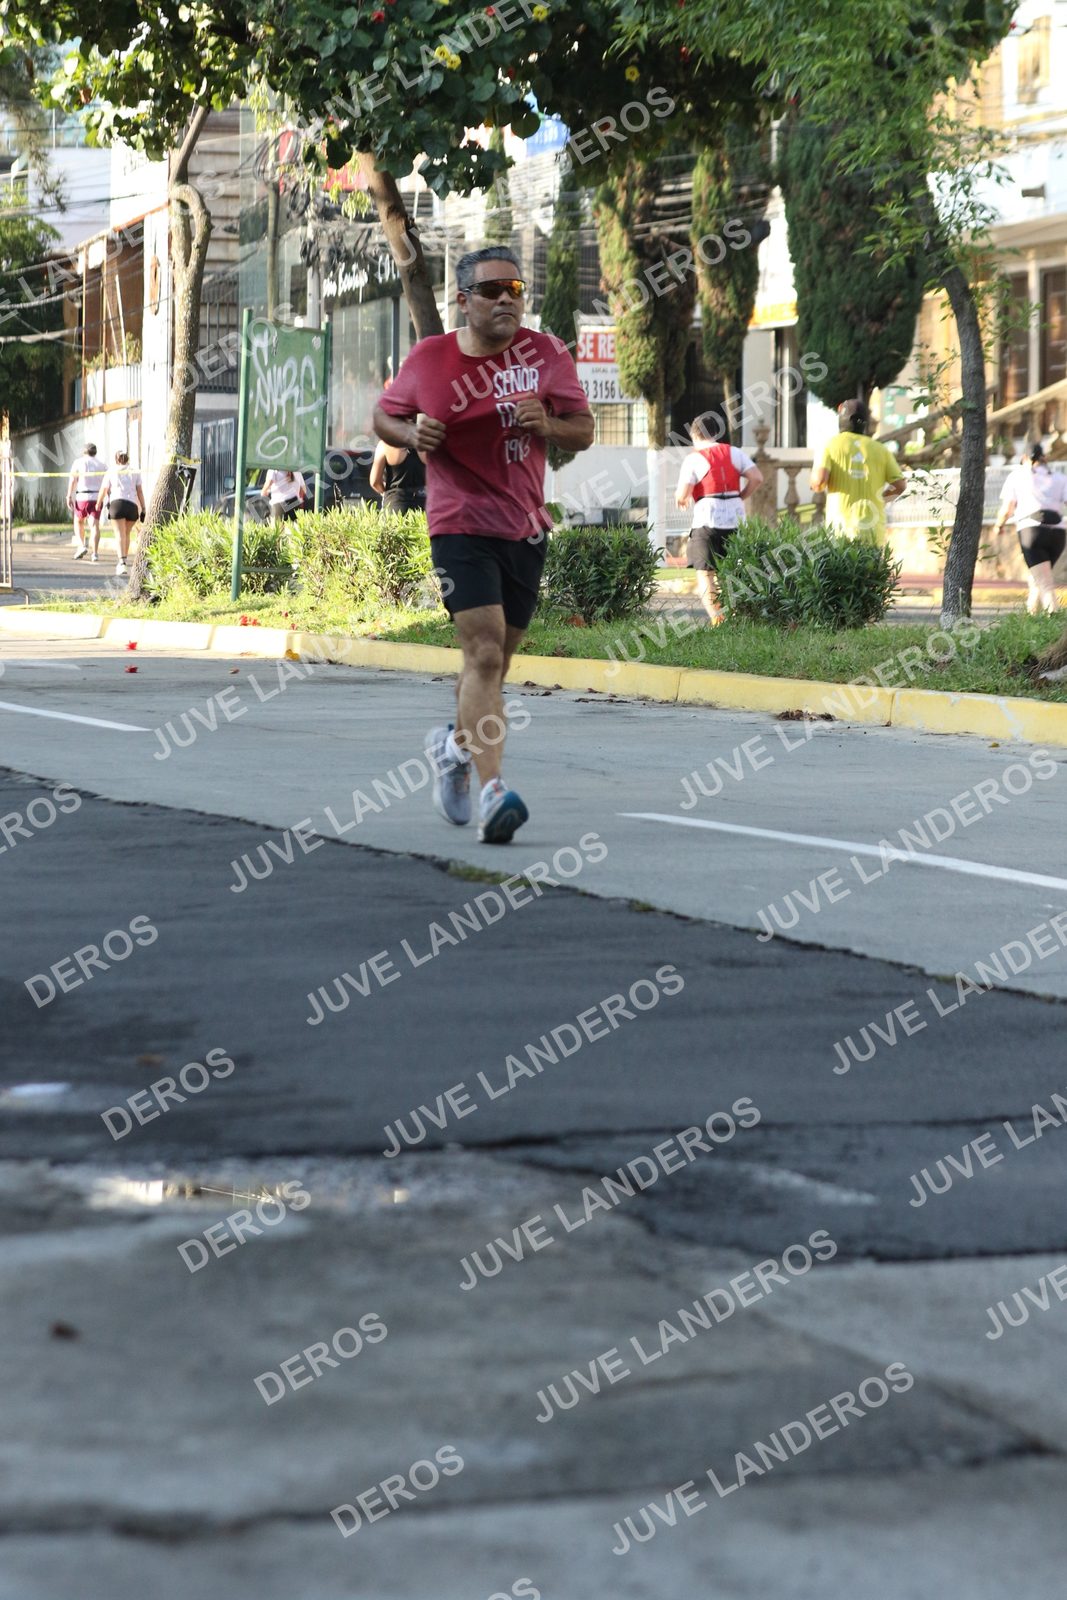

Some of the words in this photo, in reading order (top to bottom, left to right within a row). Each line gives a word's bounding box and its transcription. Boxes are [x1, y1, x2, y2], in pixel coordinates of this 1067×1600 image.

[577, 332, 594, 359] SE
[598, 332, 615, 359] RE
[493, 365, 540, 399] SEÑOR
[593, 380, 616, 399] 3156
